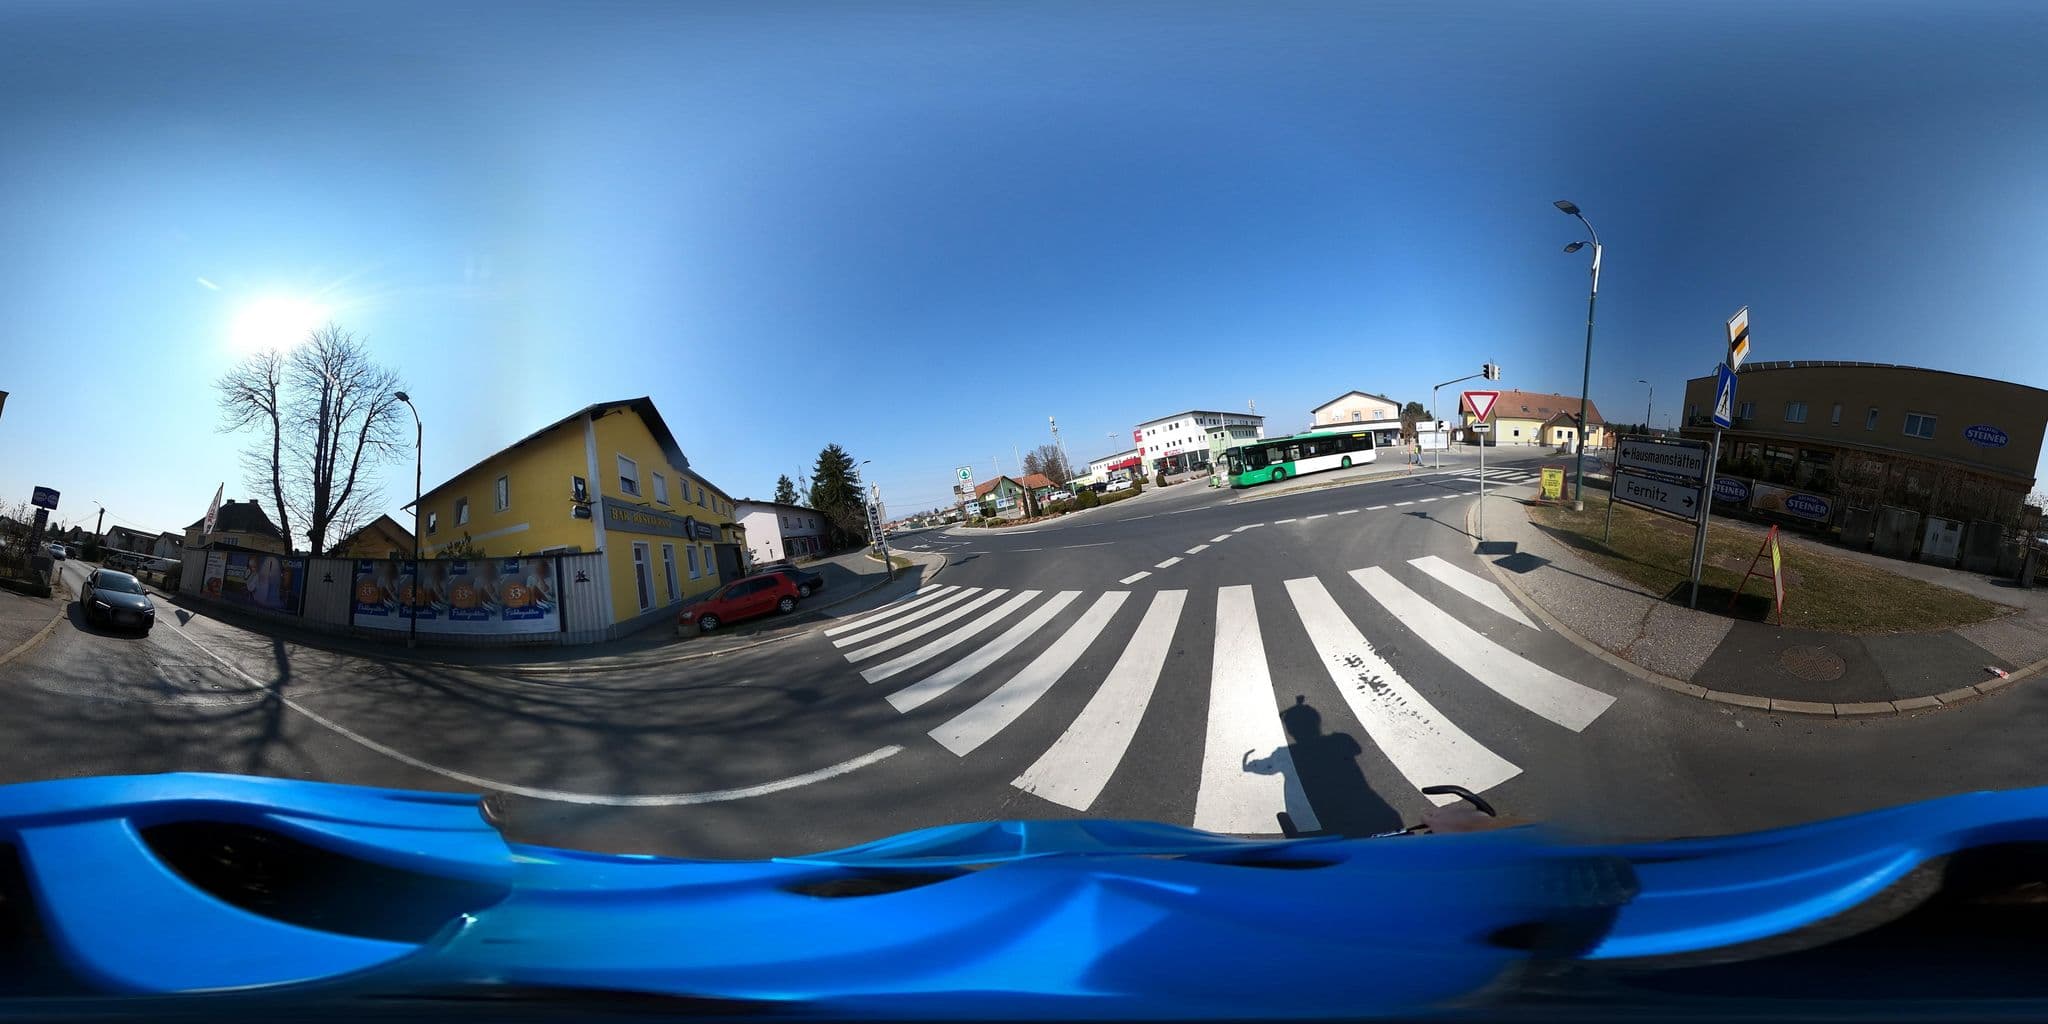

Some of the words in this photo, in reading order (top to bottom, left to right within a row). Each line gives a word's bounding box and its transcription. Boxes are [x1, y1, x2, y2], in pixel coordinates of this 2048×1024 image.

[1967, 429, 2006, 444] STEINER
[1630, 447, 1701, 471] Hausmannstätten
[1626, 481, 1668, 503] Fernitz
[1787, 499, 1827, 515] STEINER
